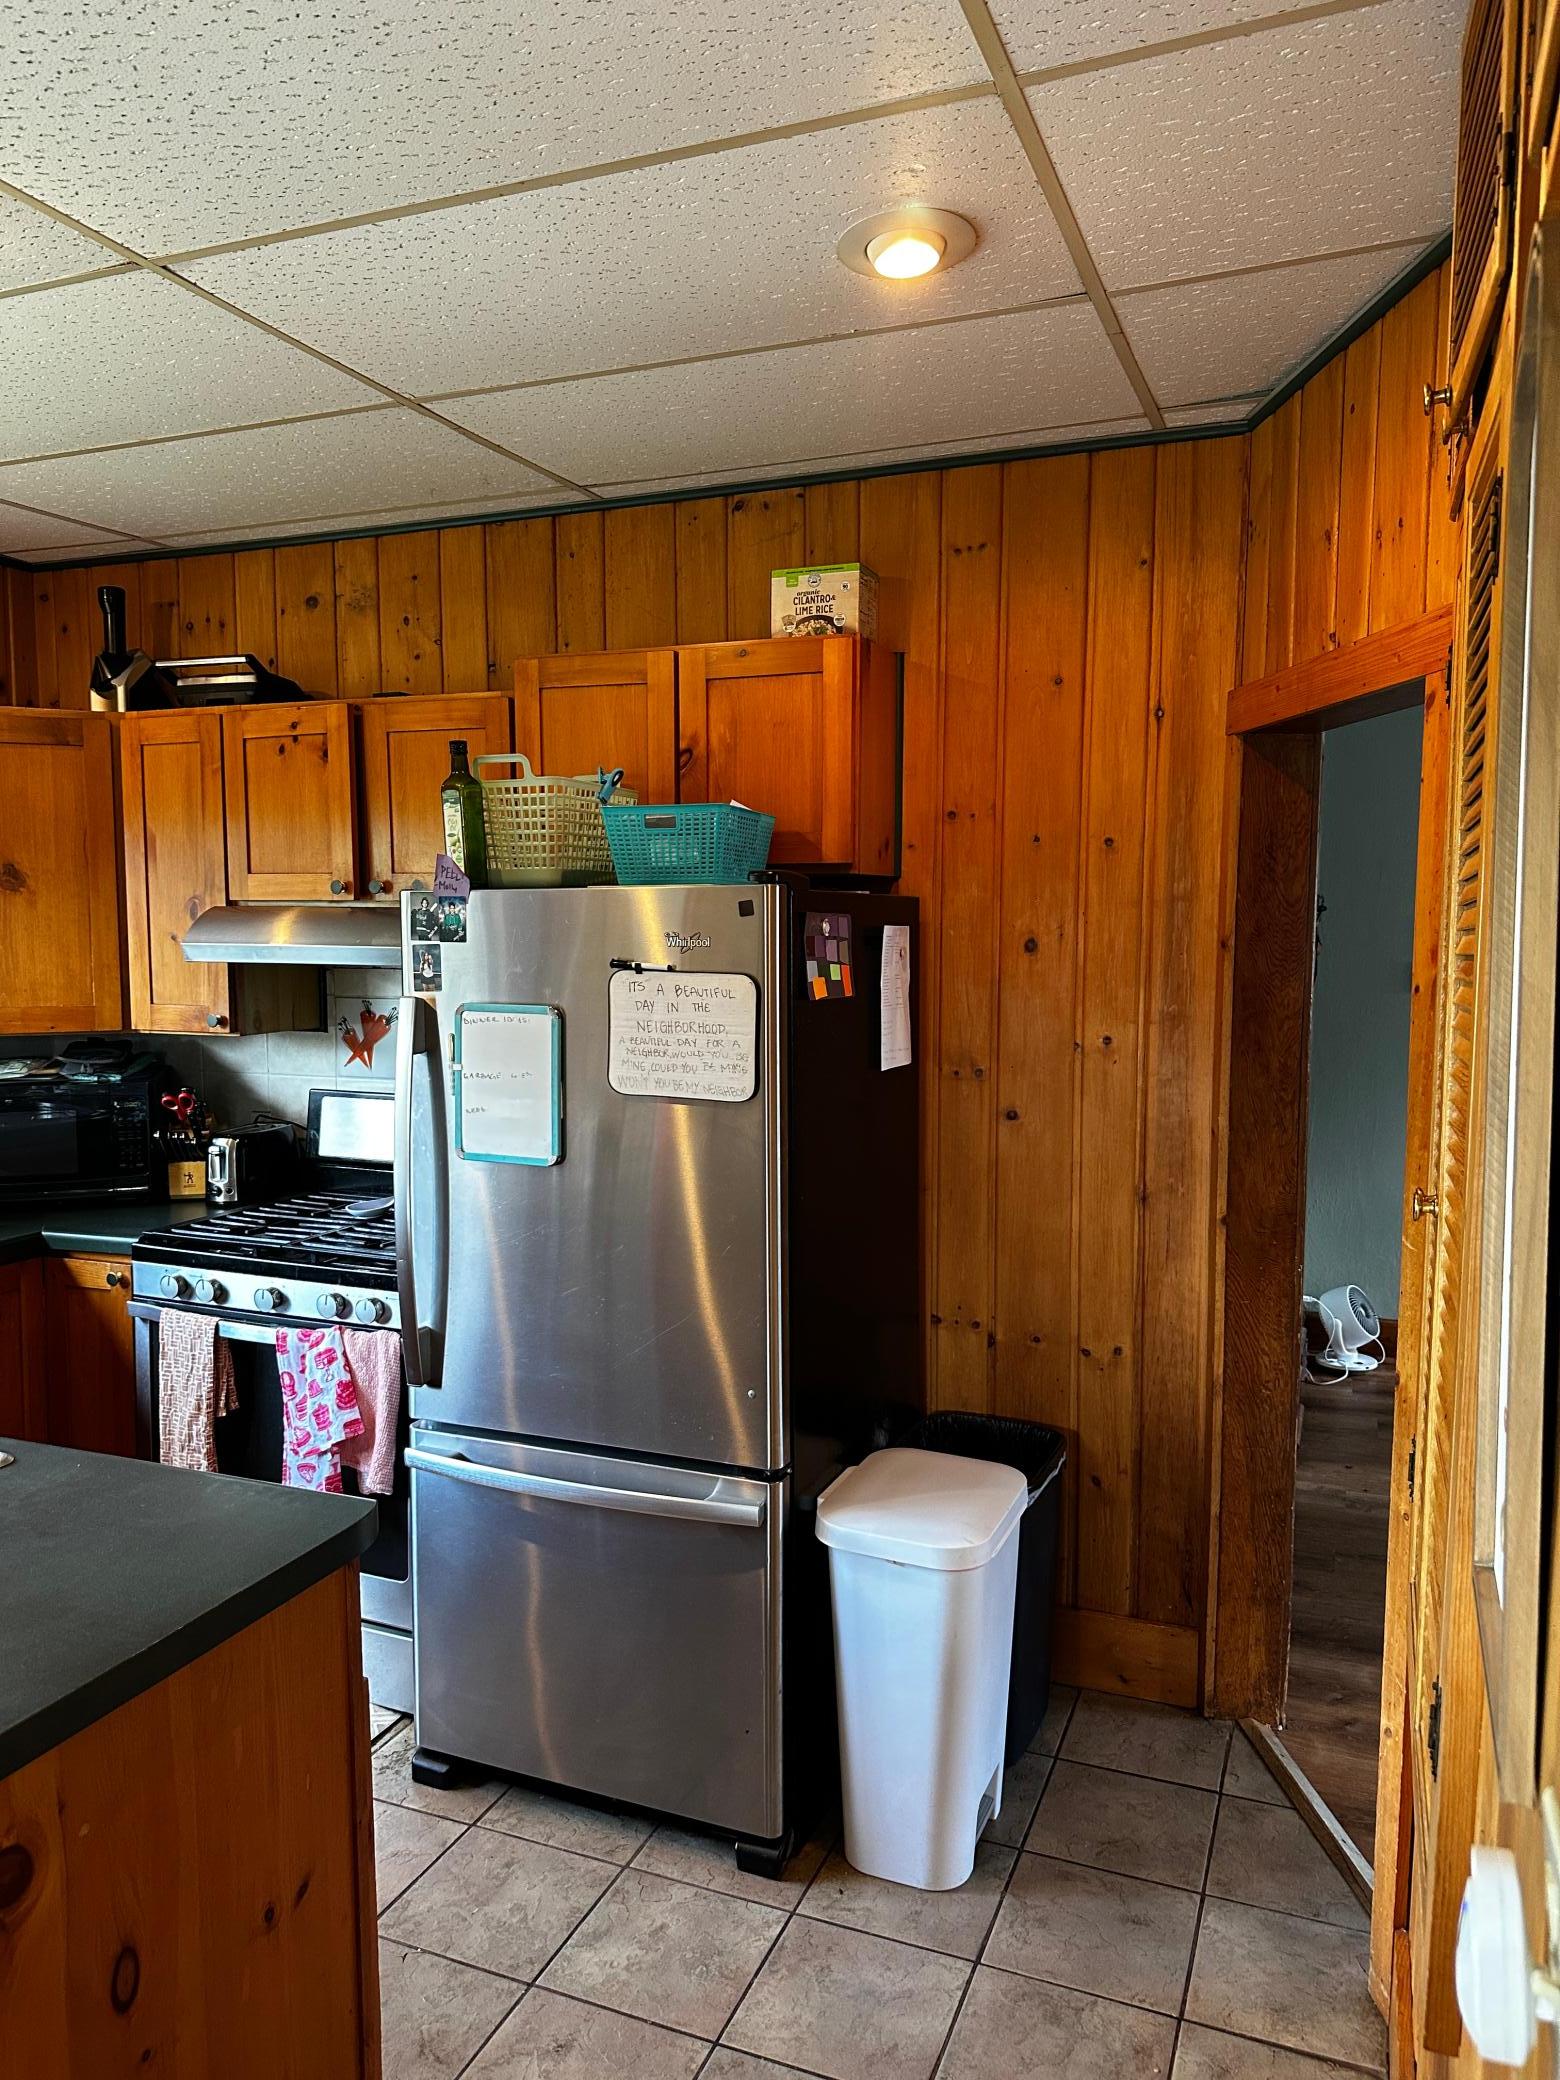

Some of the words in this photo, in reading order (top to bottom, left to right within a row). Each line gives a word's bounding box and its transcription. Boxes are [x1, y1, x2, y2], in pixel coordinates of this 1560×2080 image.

[796, 589, 821, 597] organic
[793, 594, 831, 605] CILANTRO
[795, 606, 813, 616] LIME
[815, 604, 834, 614] RICE
[665, 934, 712, 951] Whirlpool
[656, 983, 665, 996] A
[674, 984, 736, 999] BEAUTIFUL
[635, 1000, 655, 1014] DAY
[667, 1001, 679, 1014] IN
[692, 1001, 711, 1013] THE
[463, 1016, 500, 1025] DINNER
[619, 1036, 626, 1045] A
[630, 1036, 671, 1047] BEAUTIFUL
[677, 1038, 697, 1048] DAY
[706, 1039, 725, 1048] FOR
[732, 1040, 741, 1049] A
[681, 1062, 698, 1074] YOU
[653, 1077, 671, 1089] YOU
[672, 1079, 684, 1092] BE
[685, 1080, 700, 1095] MY
